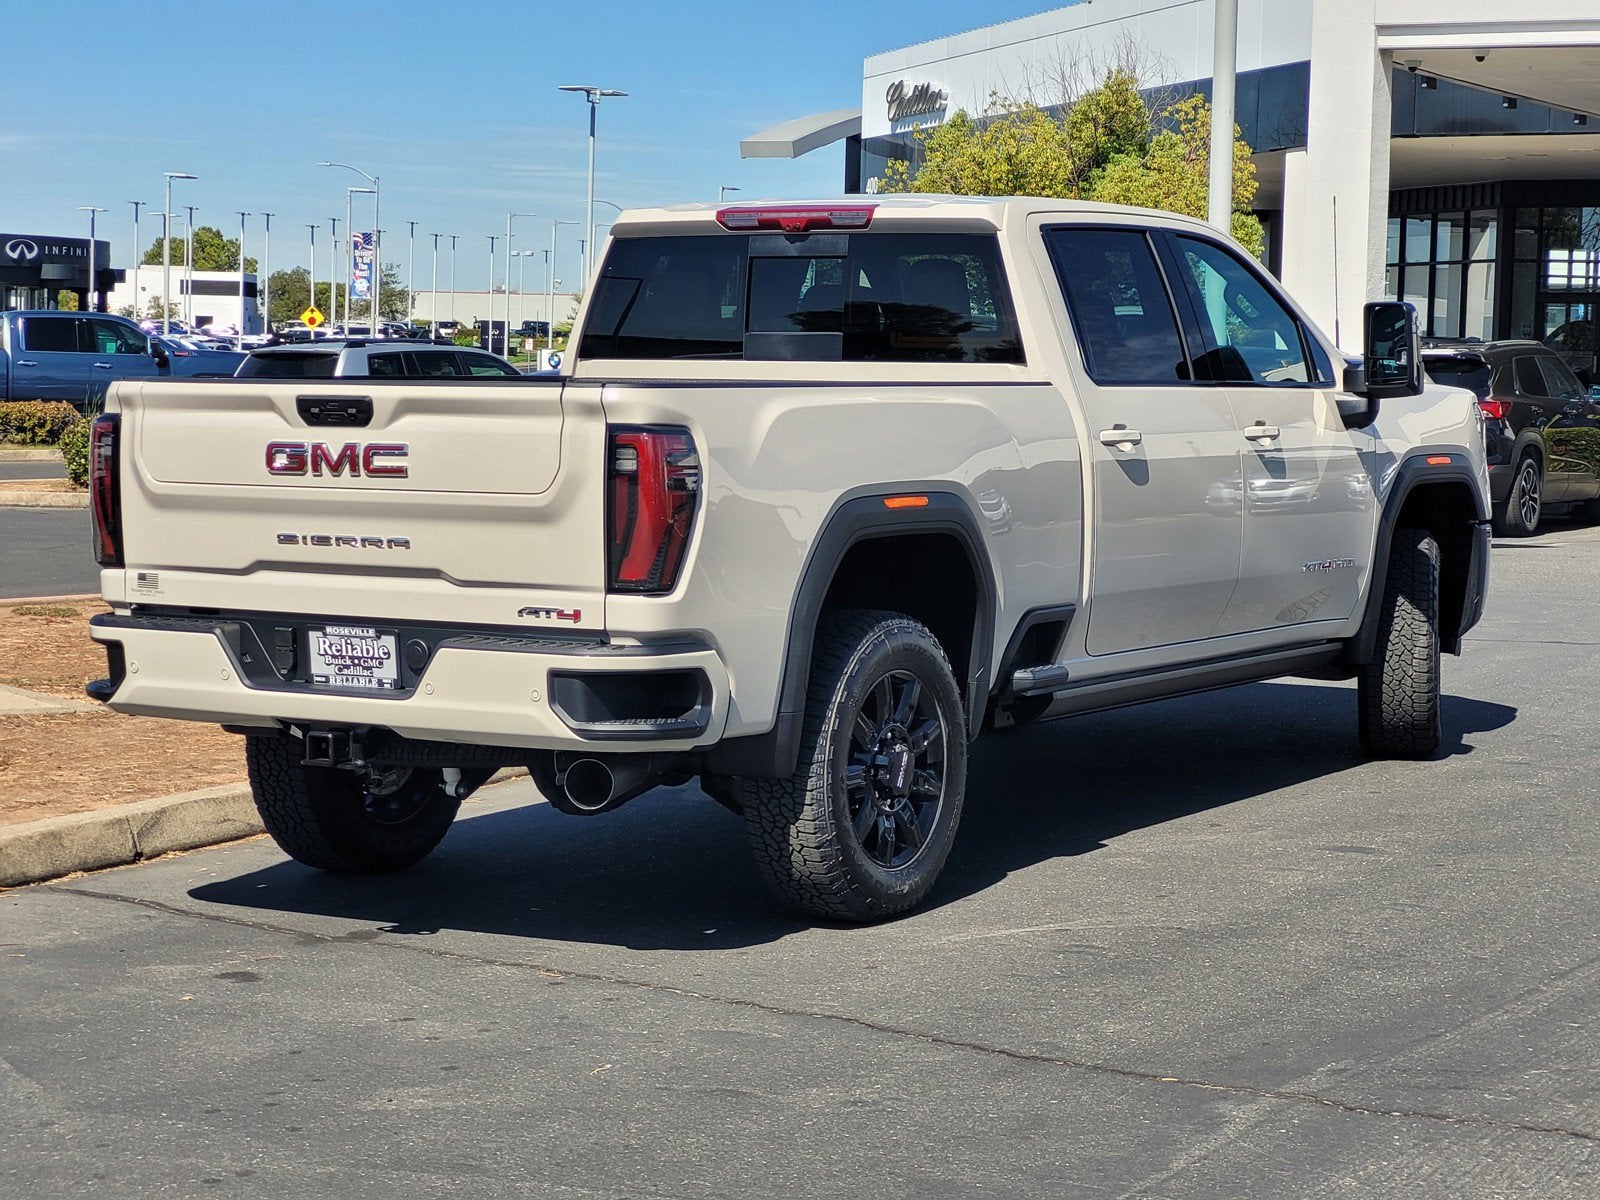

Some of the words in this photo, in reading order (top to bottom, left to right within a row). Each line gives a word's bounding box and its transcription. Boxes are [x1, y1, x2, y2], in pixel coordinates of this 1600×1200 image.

[886, 80, 948, 122] Cadillac
[265, 440, 410, 478] GMC
[276, 533, 411, 550] SIERRA
[517, 606, 582, 624] AT4
[326, 627, 375, 637] ROSEVILLE
[318, 637, 390, 659] Reliable
[324, 654, 353, 666] Buick
[360, 657, 384, 669] GMC
[334, 664, 374, 677] Cadillac
[328, 675, 379, 688] RELIABLE
